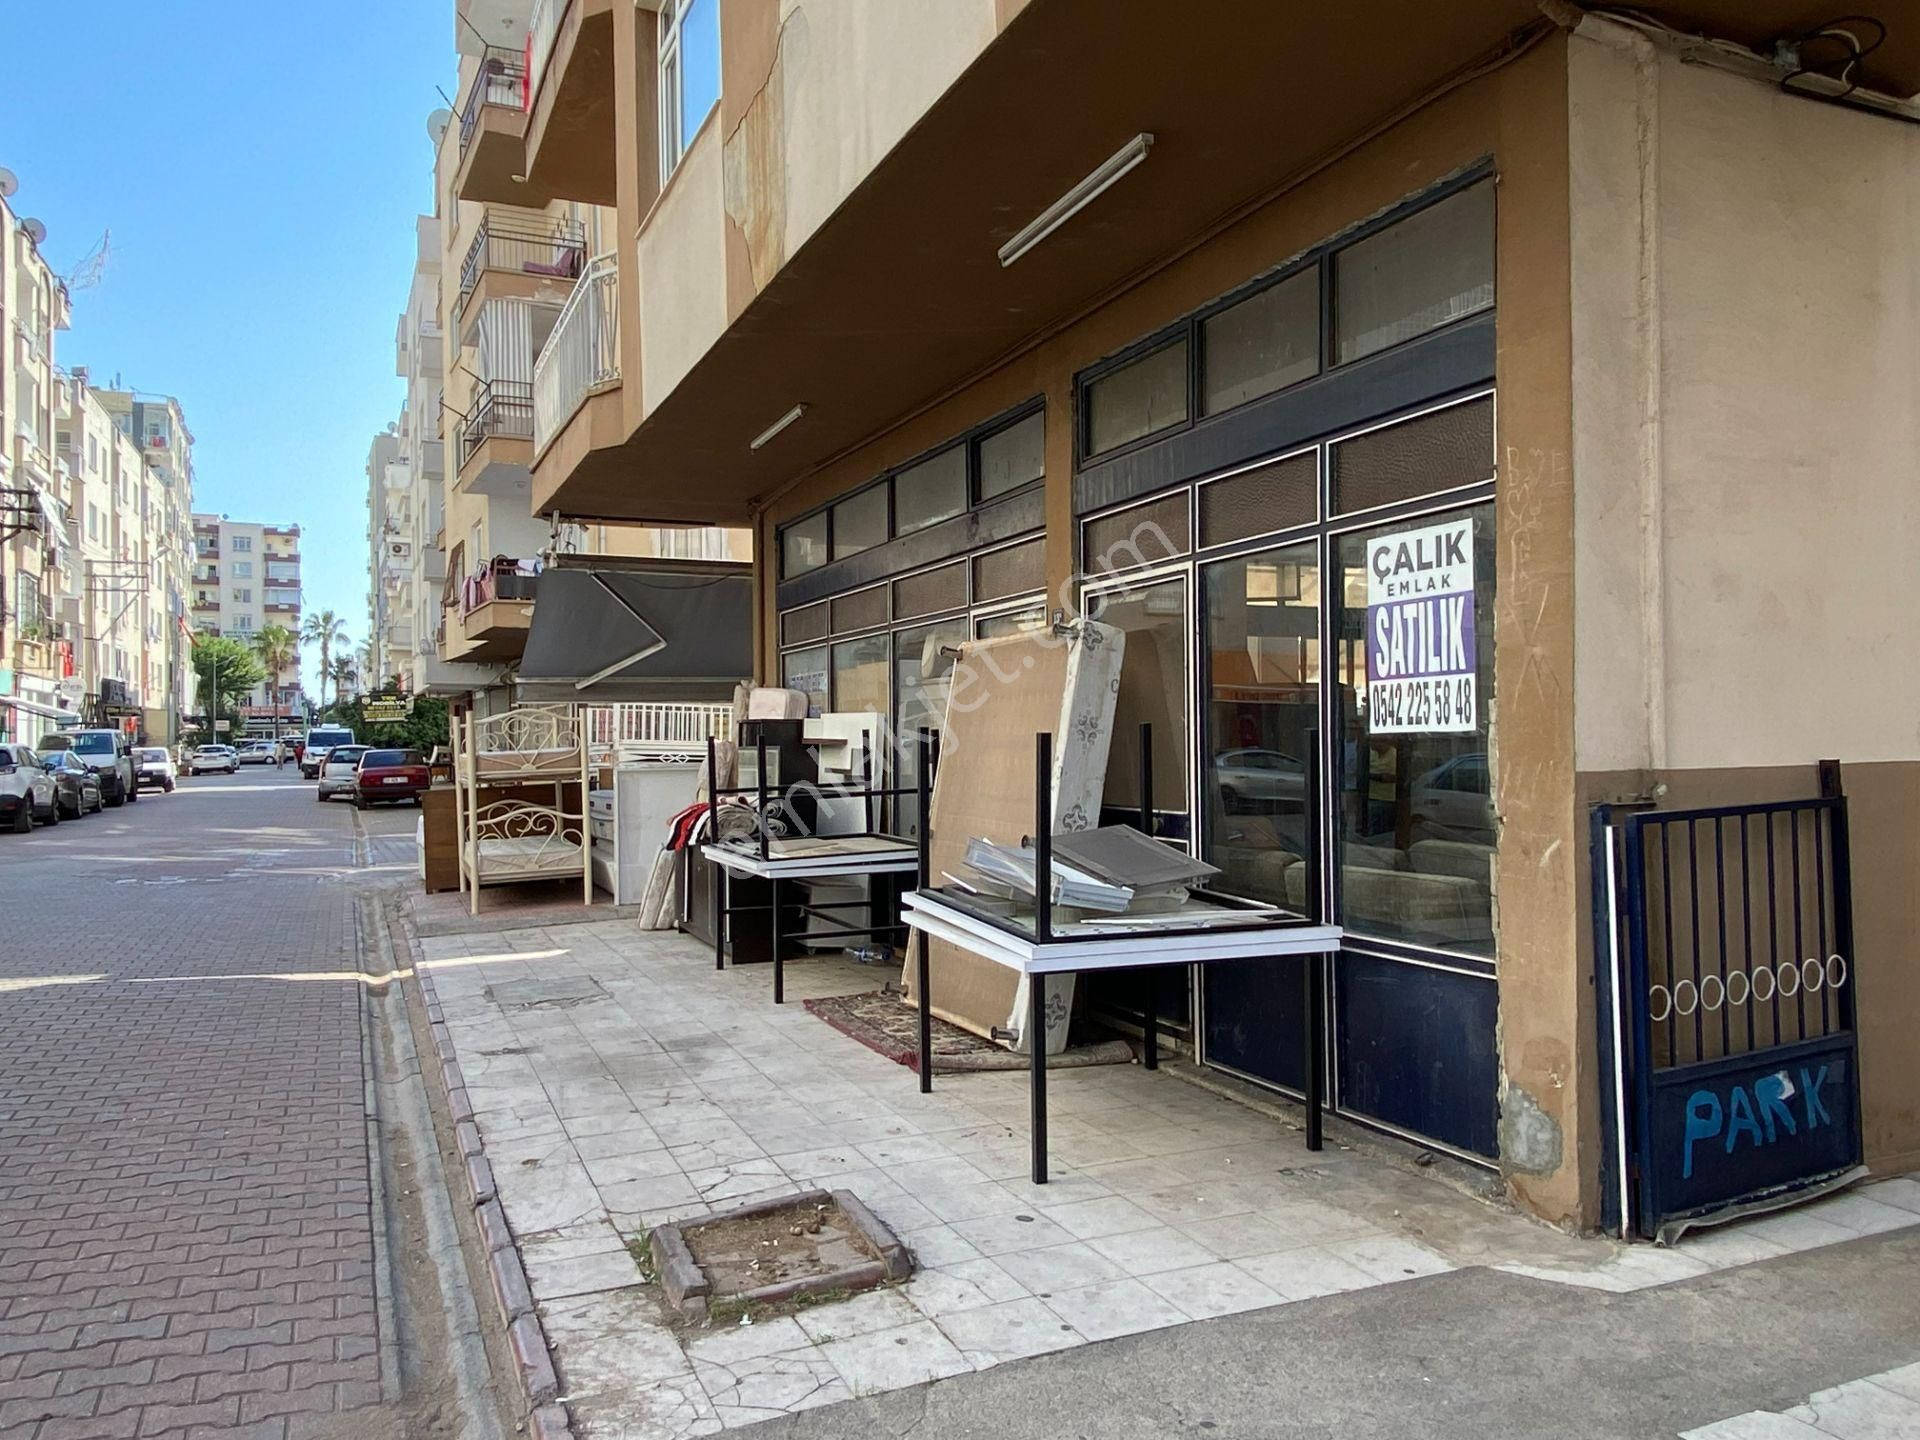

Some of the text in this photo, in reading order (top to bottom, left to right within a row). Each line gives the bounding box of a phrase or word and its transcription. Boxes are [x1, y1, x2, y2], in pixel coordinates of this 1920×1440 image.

[1373, 530, 1466, 584] ÇALIK
[1387, 574, 1451, 597] EMLAK
[1376, 596, 1466, 678] SATILIK
[1373, 677, 1471, 727] 0542 225 58 48
[1684, 1065, 1831, 1179] PARK
